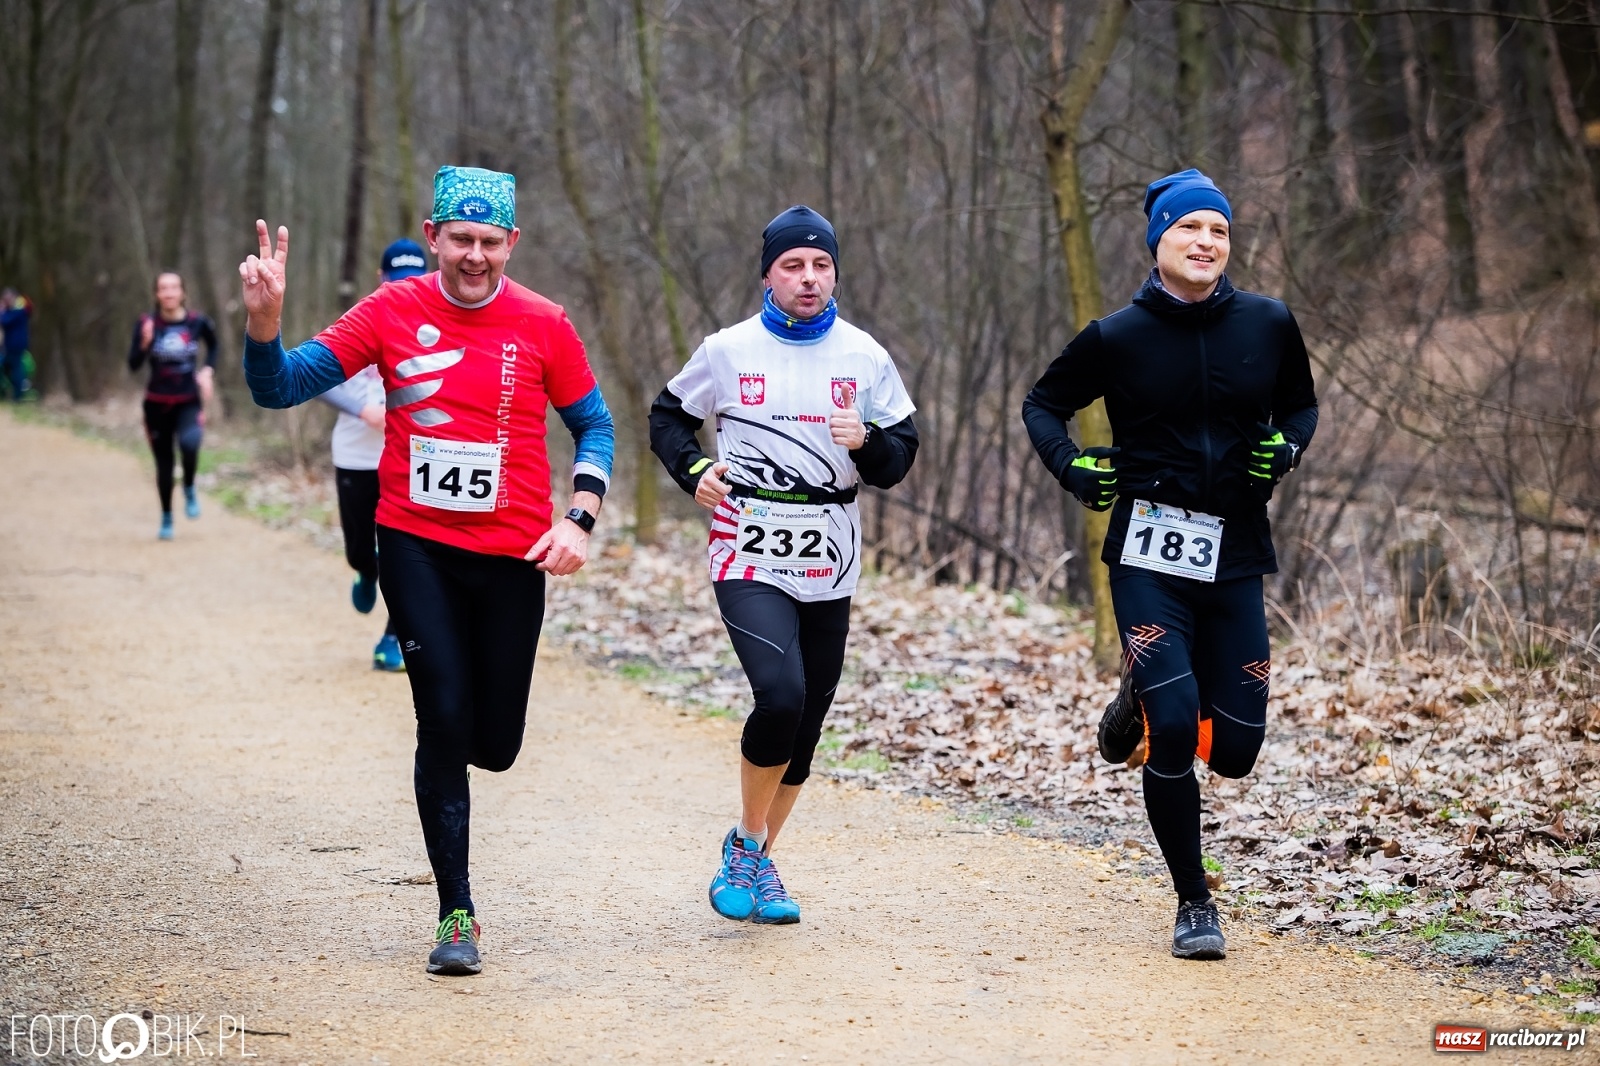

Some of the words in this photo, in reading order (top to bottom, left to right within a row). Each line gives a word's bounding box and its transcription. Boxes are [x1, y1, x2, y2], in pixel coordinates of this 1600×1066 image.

[497, 343, 517, 425] ATHLETICS
[439, 448, 497, 459] www.personalbest.pl
[496, 427, 511, 508] EUROVENT
[416, 462, 493, 499] 145
[771, 511, 825, 520] www.personalbest.pl
[1164, 512, 1220, 530] www.personalbest.pl
[741, 524, 822, 558] 232
[1134, 526, 1213, 568] 183
